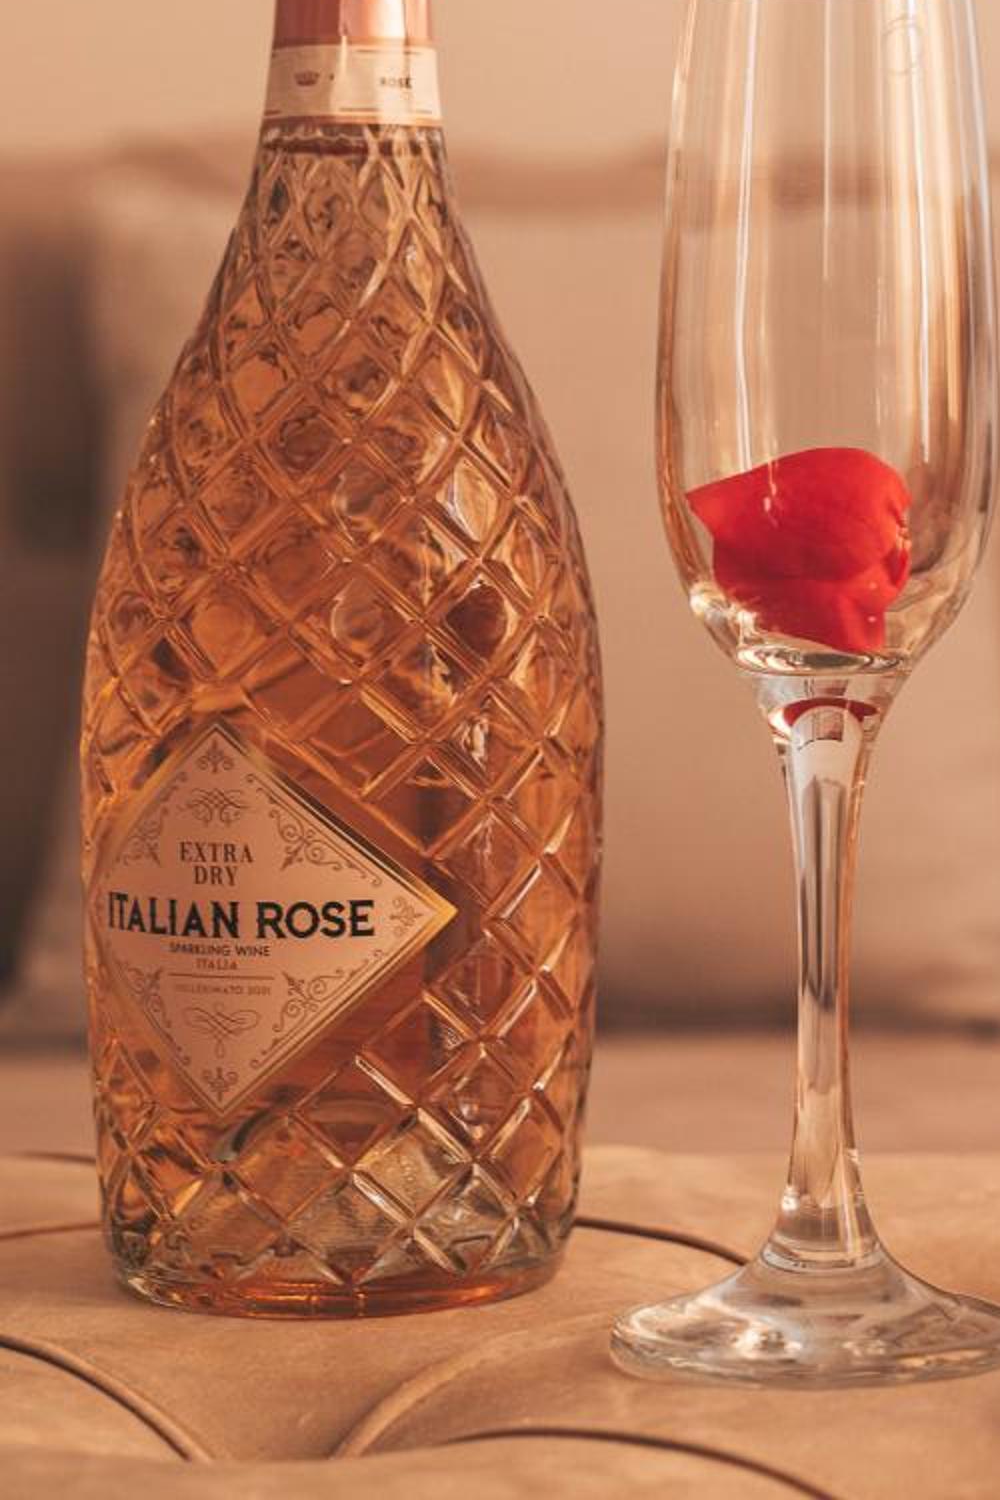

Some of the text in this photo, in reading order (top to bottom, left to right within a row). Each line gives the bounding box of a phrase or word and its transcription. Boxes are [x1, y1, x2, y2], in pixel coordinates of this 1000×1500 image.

[179, 841, 255, 864] EXTRA
[193, 865, 239, 887] DRY
[108, 891, 376, 938] ITALIAN ROSE
[169, 941, 272, 957] SPARKLING WINE
[196, 958, 238, 970] ITALIA
